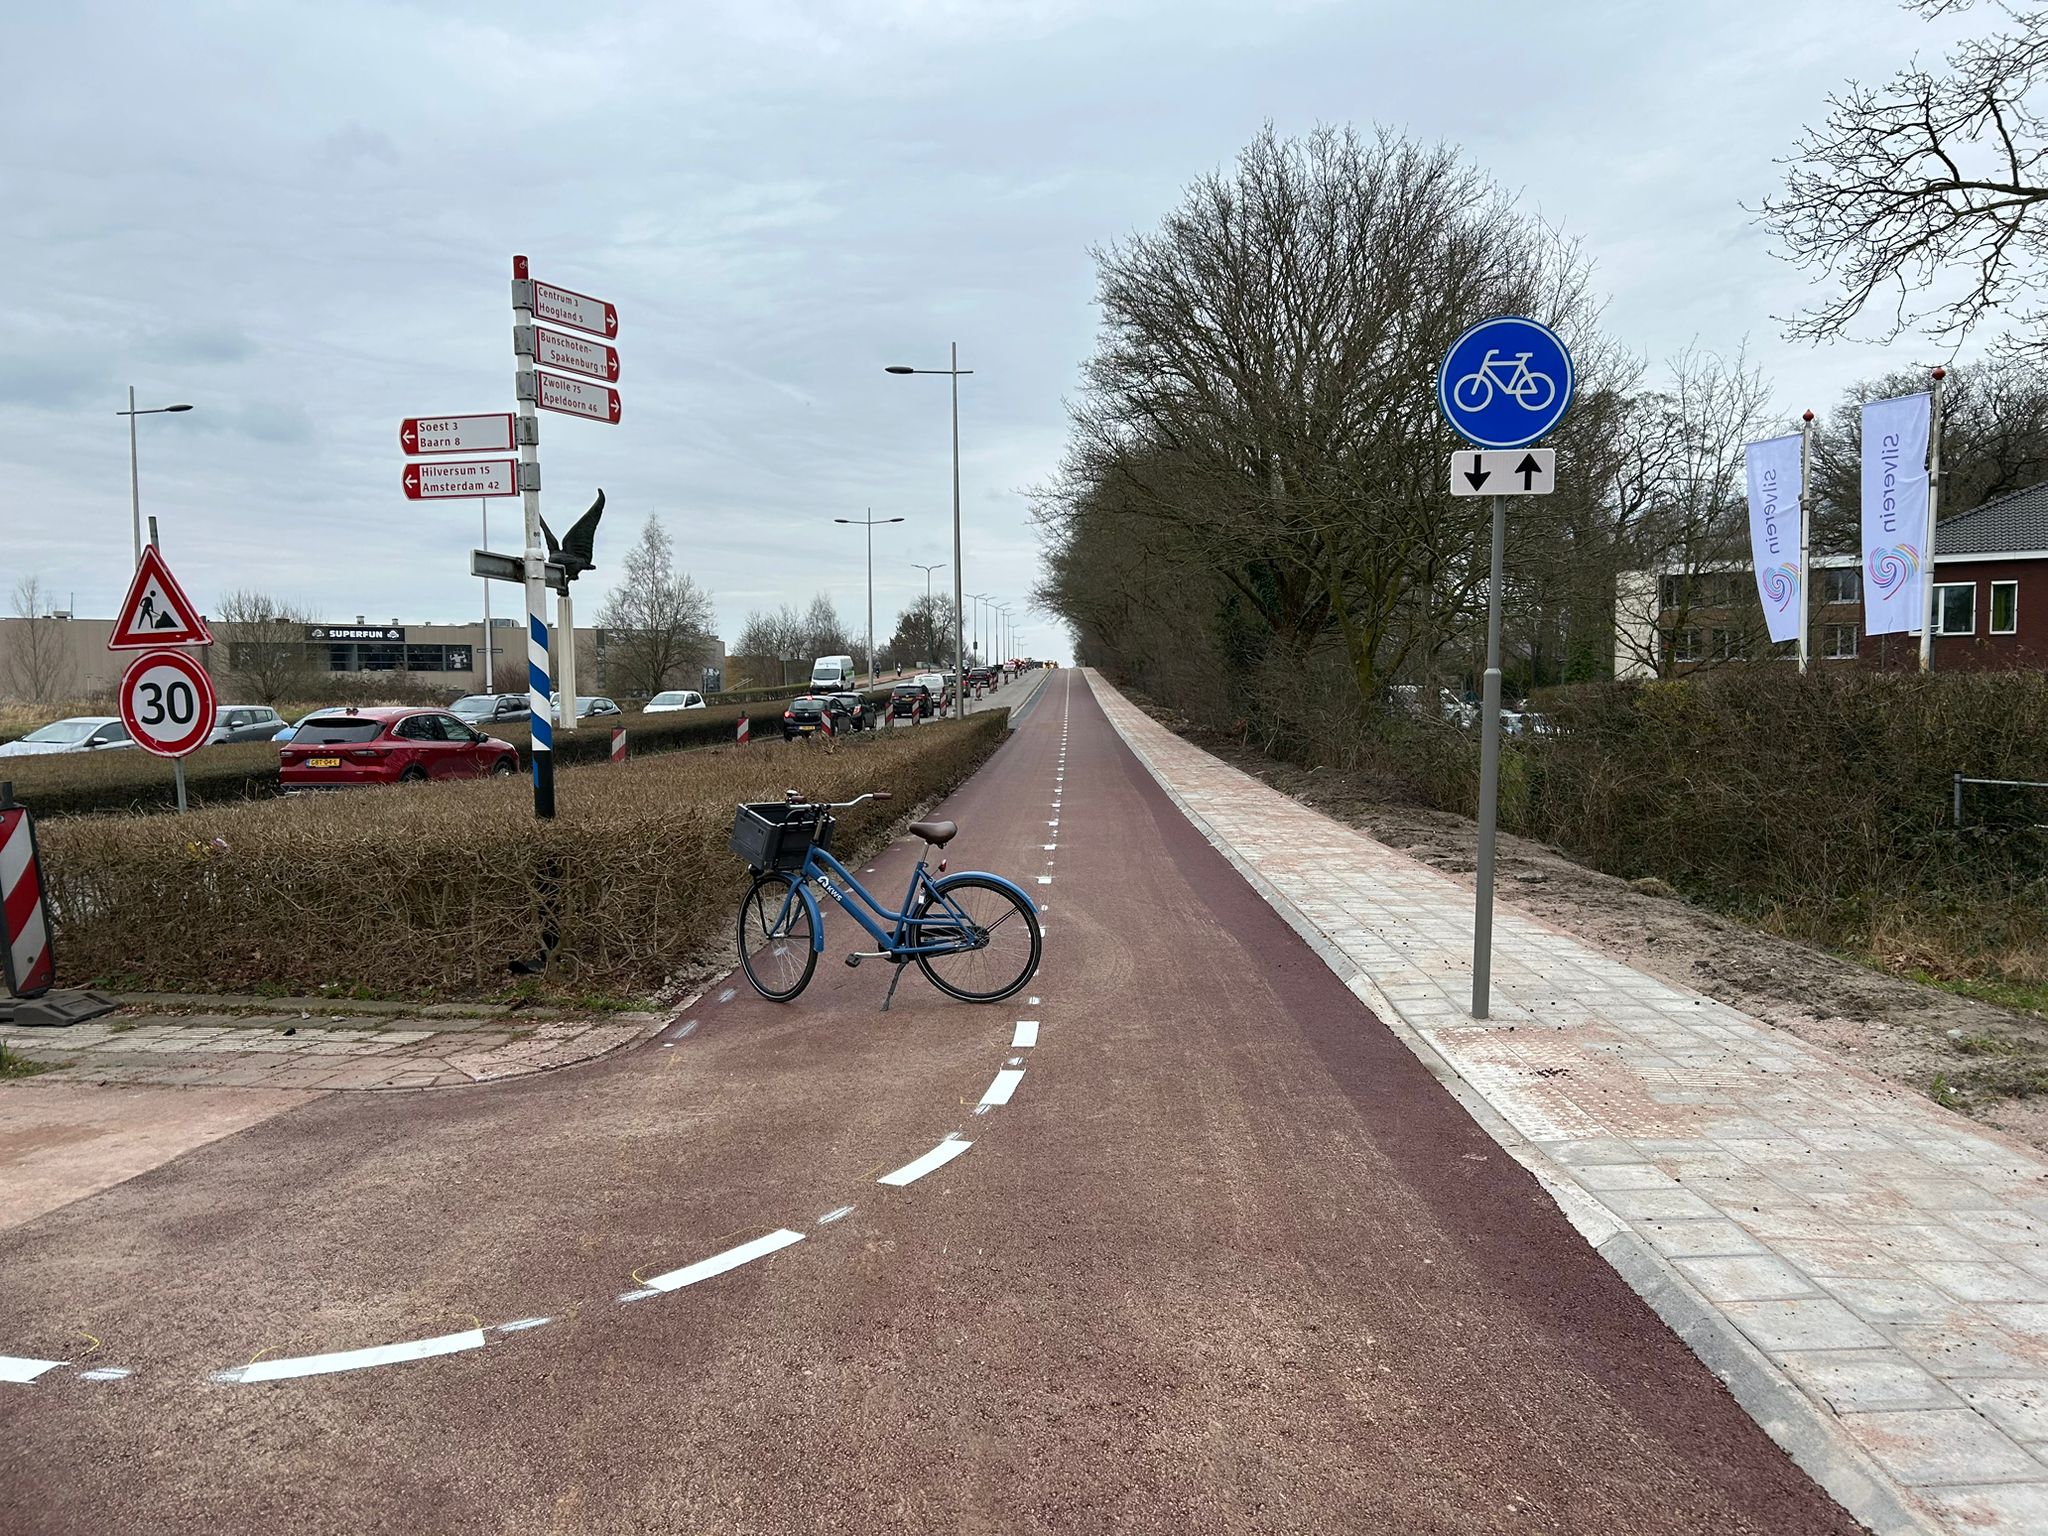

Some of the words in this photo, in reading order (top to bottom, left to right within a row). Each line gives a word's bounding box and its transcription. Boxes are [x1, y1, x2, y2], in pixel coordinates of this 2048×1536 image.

[539, 287, 573, 304] Centrum
[574, 299, 579, 307] 3
[539, 302, 577, 321] Hoogland
[579, 315, 584, 323] 5
[541, 331, 592, 354] Bunschoten-
[550, 350, 599, 373] Spakenburg
[600, 364, 607, 374] 11
[543, 376, 571, 391] Zwolle
[572, 384, 581, 394] 75
[543, 392, 586, 410] Apeldoorn
[588, 403, 598, 413] 46
[419, 421, 449, 432] Soest
[452, 422, 458, 431] 3
[420, 437, 451, 448] Baarn
[454, 437, 461, 446] 8
[422, 466, 476, 477] Hilversum
[480, 466, 490, 475] 15
[422, 481, 484, 493] Amsterdam
[488, 481, 500, 490] 42
[329, 629, 383, 639] SUPERFUN
[139, 681, 194, 725] 30
[826, 885, 843, 902] KWS
